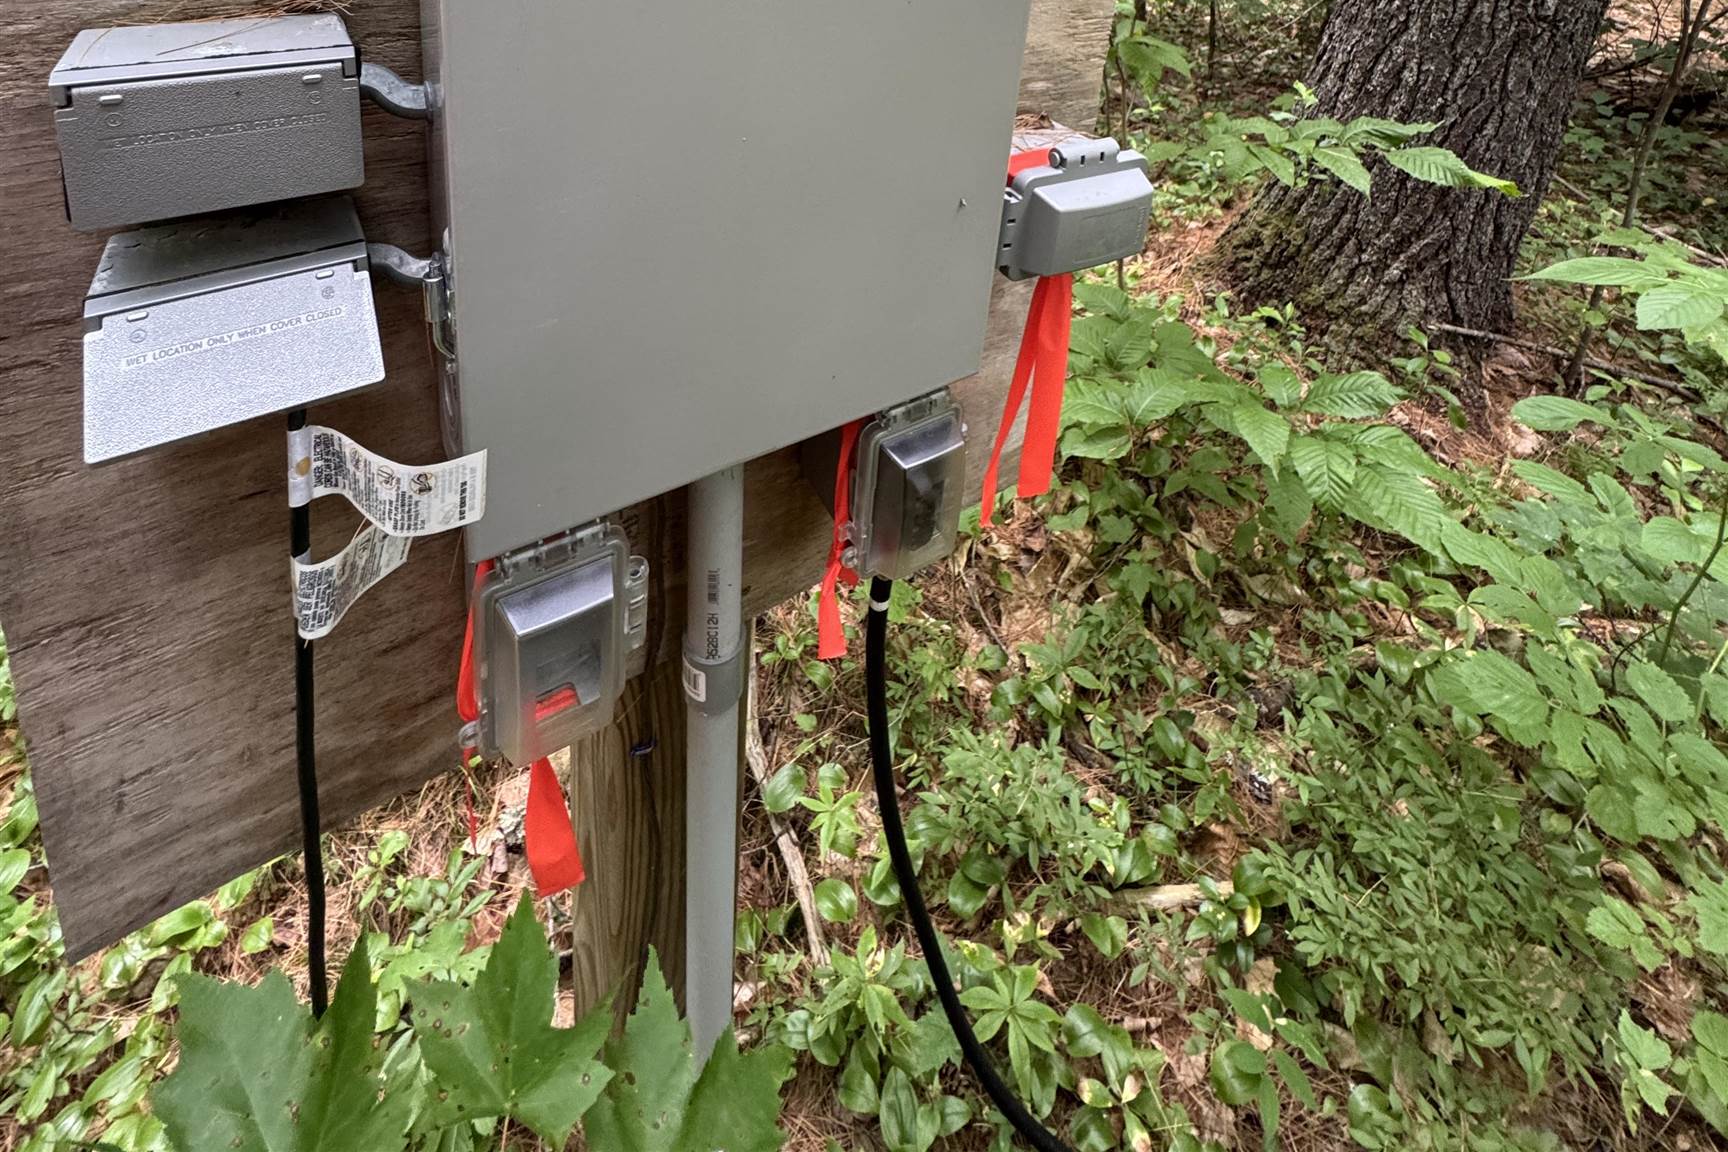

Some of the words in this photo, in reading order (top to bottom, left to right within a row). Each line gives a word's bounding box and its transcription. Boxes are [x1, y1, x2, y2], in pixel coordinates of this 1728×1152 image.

[125, 354, 148, 367] WET
[152, 341, 203, 361] LOCATION
[207, 334, 234, 347] ONLY
[237, 325, 266, 339] WHEN
[270, 318, 302, 331] COVER
[306, 307, 342, 323] CLOSED
